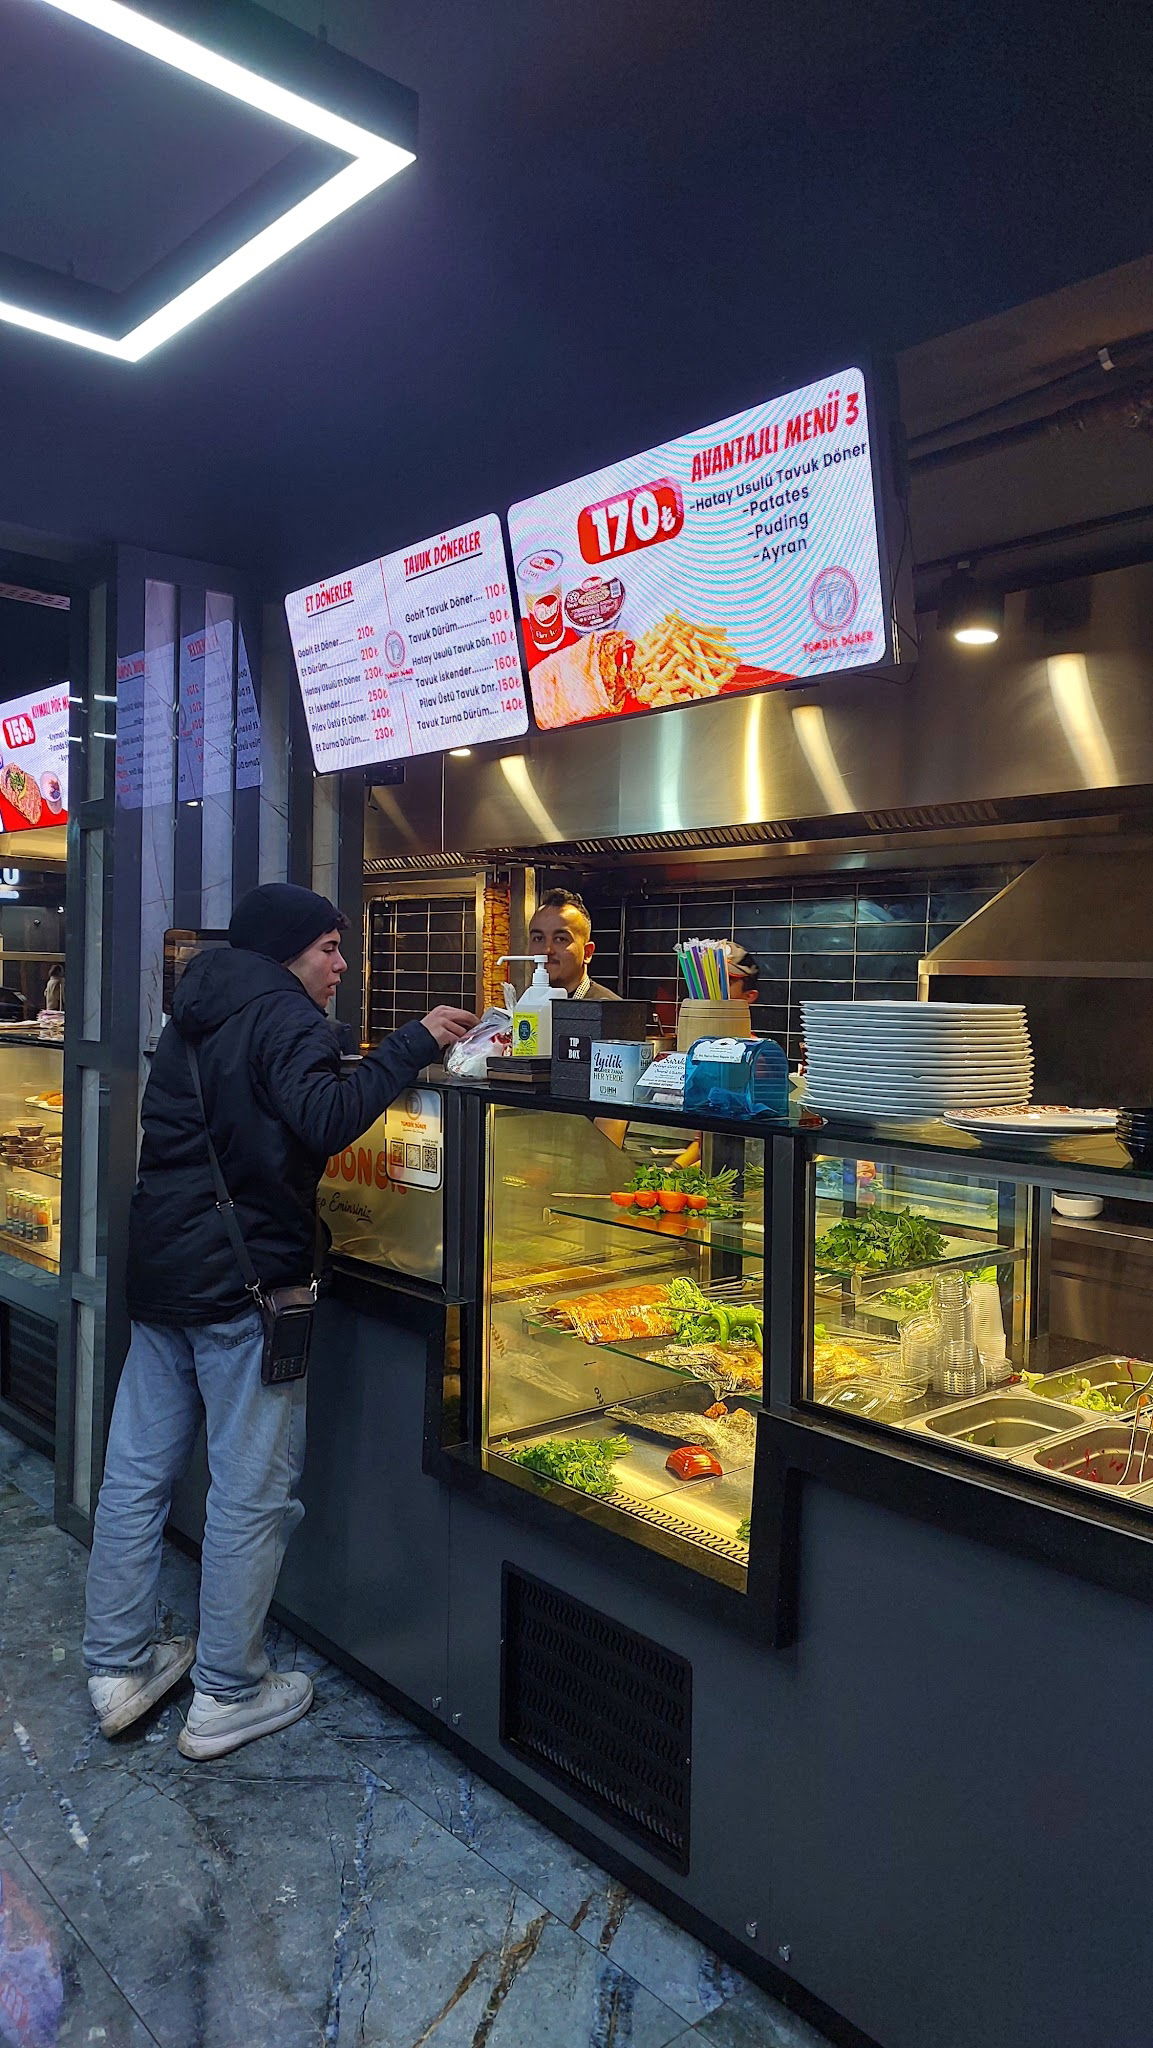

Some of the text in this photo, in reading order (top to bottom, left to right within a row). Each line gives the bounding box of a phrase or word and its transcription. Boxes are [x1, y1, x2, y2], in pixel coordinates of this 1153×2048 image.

[691, 389, 859, 483] AVANTAJLI MENÜ 3
[736, 473, 773, 497] Usulü
[776, 458, 819, 484] Tavuk
[823, 442, 867, 468] Döner
[403, 530, 481, 576] TAVUK DÖNERLER
[305, 580, 353, 613] ET DÖNERLER
[405, 609, 425, 623] Gobit
[426, 601, 449, 617] Tavuk
[408, 629, 431, 644] Tavuk
[297, 644, 314, 658] Gobit
[314, 642, 320, 652] Et
[412, 653, 432, 666] Hatay
[433, 647, 453, 661] Usulü
[453, 642, 475, 655] Tavuk
[301, 668, 307, 677] Et
[321, 679, 337, 692] Usulü
[337, 678, 344, 687] Et
[344, 674, 361, 687] Döner
[415, 675, 438, 688] Tavuk
[419, 696, 437, 709] Pilav
[438, 692, 455, 705] Üstü
[456, 686, 480, 699] Tavuk
[308, 706, 315, 715] Et
[311, 723, 327, 733] Pilav
[327, 718, 341, 730] Üstü
[341, 716, 348, 726] Et
[417, 718, 439, 730] Tavuk
[440, 713, 462, 726] Zurna
[315, 743, 322, 752] Et
[322, 739, 340, 751] Zurna
[569, 1037, 580, 1047] TIP
[568, 1049, 580, 1059] BOX
[593, 1073, 624, 1083] HER YERDE
